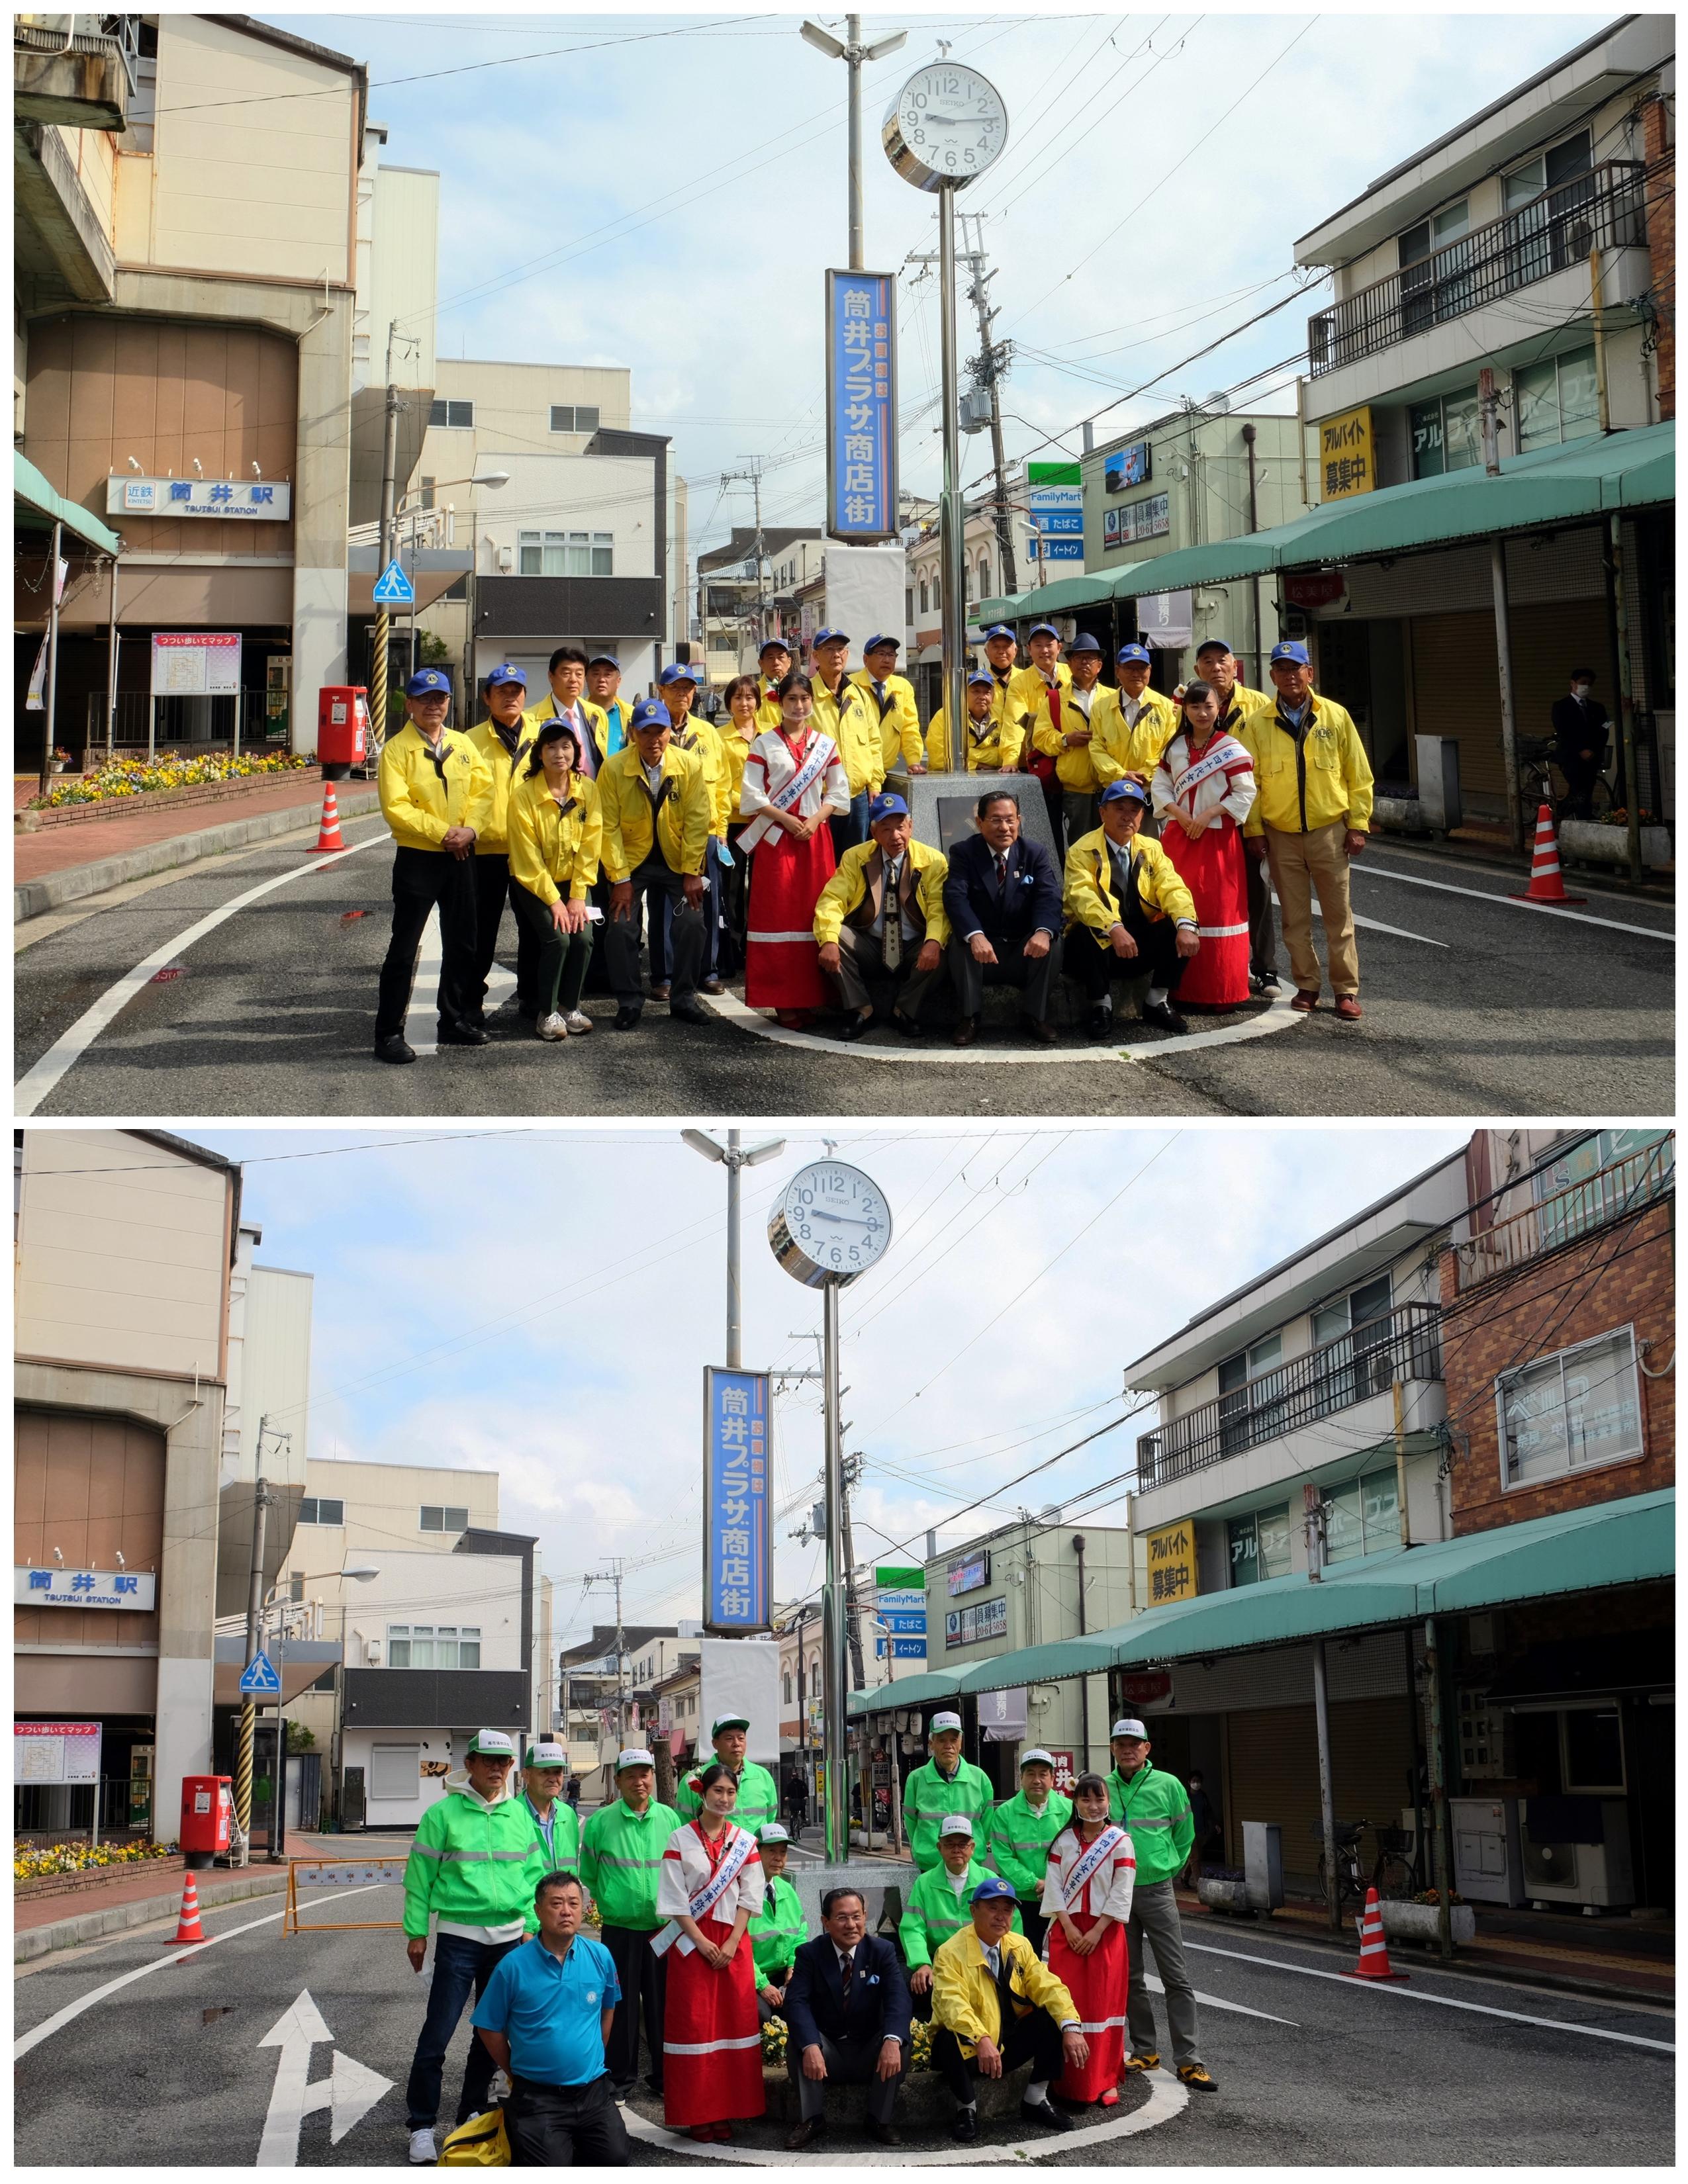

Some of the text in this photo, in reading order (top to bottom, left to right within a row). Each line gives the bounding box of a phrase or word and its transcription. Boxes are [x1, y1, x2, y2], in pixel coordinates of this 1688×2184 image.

[944, 77, 959, 94] 12
[912, 92, 927, 109] 10
[977, 98, 988, 113] 2
[907, 111, 919, 126] 9
[914, 128, 925, 144] 8
[976, 136, 988, 151] 4
[928, 145, 939, 160] 7
[945, 151, 957, 166] 6
[964, 148, 975, 163] 5
[843, 289, 876, 523] 筒井プラザ商店街
[1324, 418, 1365, 453] アルバイト
[1326, 454, 1366, 496] 募集中
[128, 486, 153, 498] 近鉄
[170, 482, 273, 504] 筒井駅
[1031, 492, 1082, 503] FamilyMart
[185, 505, 258, 515] TSUTSUI STATION
[1053, 518, 1079, 529] たばこ
[1053, 545, 1078, 555] イートイン
[161, 636, 232, 645] つつい歩いてマップ
[829, 1175, 845, 1193] 12
[798, 1188, 814, 1205] 10
[825, 1197, 849, 1205] SEIKO
[862, 1198, 872, 1213] 2
[794, 1206, 805, 1222] 9
[800, 1224, 812, 1240] 8
[814, 1241, 825, 1255] 7
[861, 1234, 873, 1250] 4
[830, 1248, 842, 1263] 6
[849, 1246, 860, 1261] 5
[720, 1387, 751, 1617] 筒井プラザ商店街
[1151, 1529, 1188, 1561] アルバイト
[28, 1570, 138, 1594] 筒井駅
[1152, 1563, 1189, 1601] 募集中
[44, 1594, 121, 1604] TSUTSUI STATION
[879, 1595, 924, 1605] FamilyMart
[899, 1619, 922, 1629] たばこ
[899, 1644, 921, 1653] イートイン
